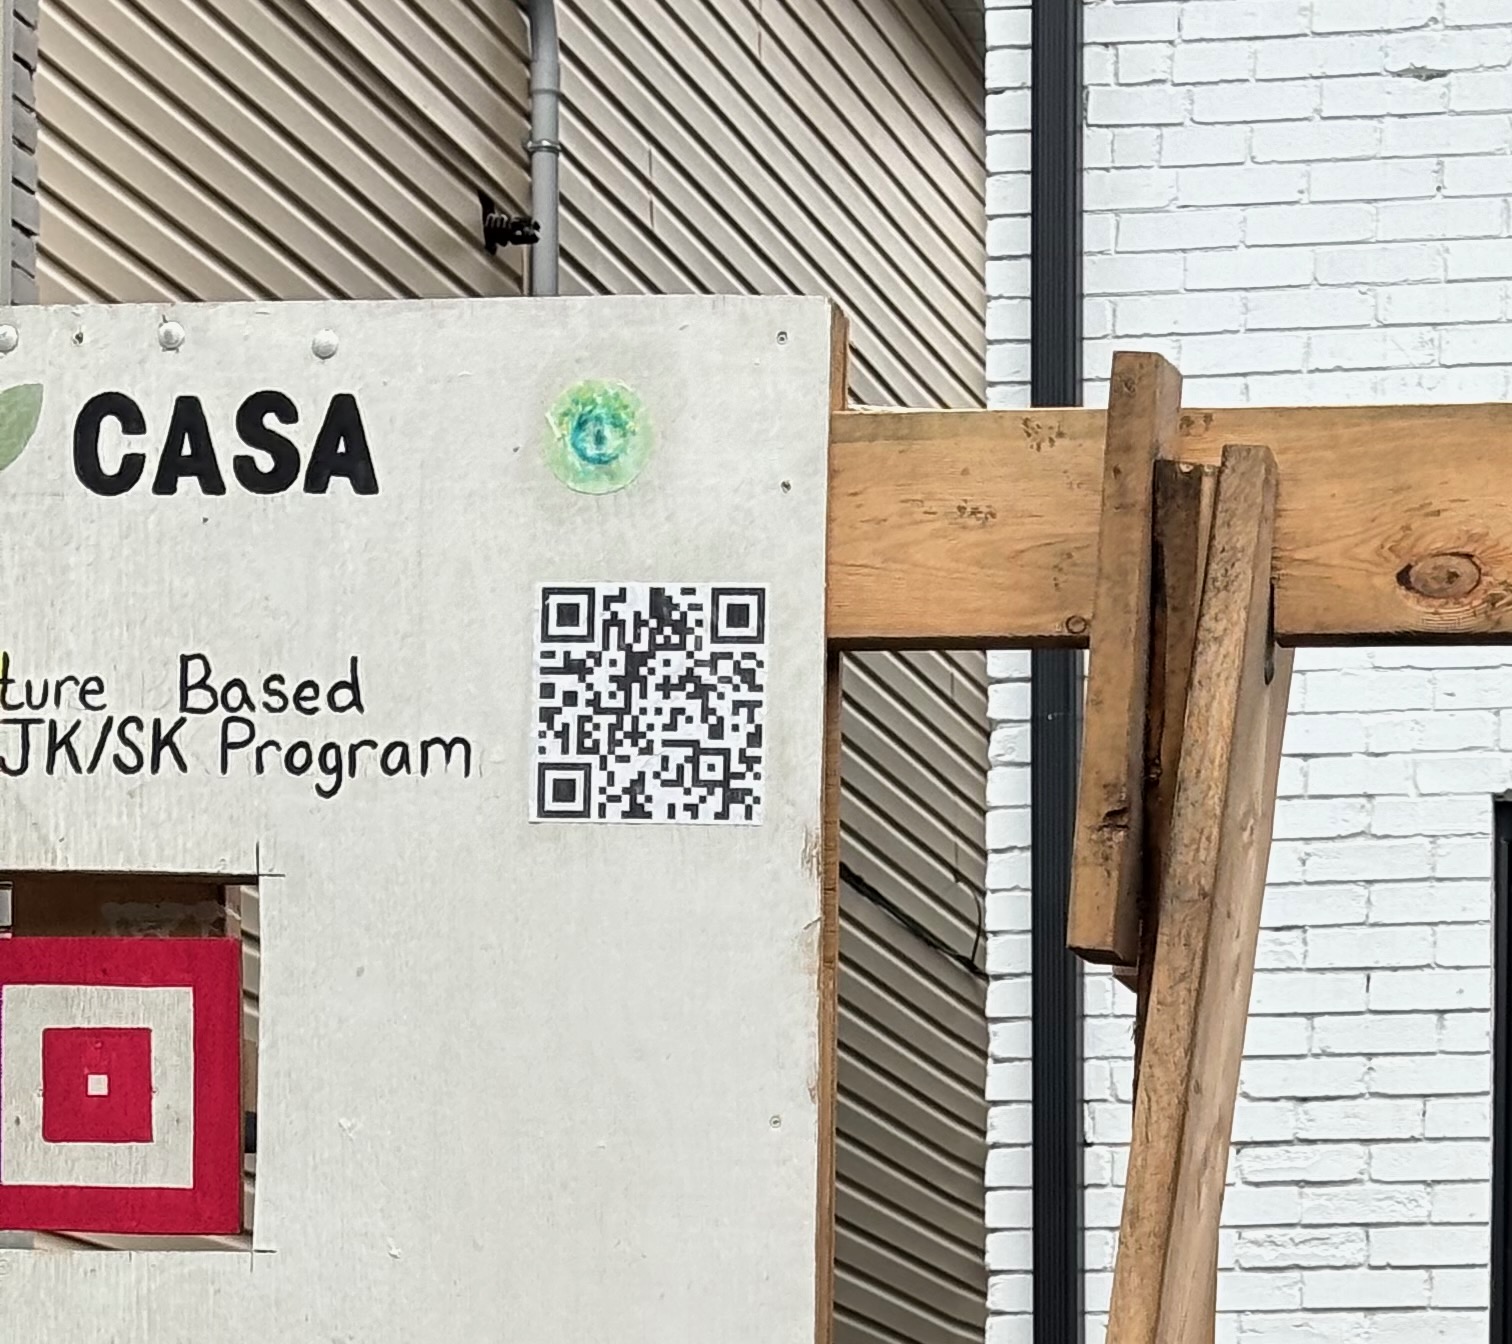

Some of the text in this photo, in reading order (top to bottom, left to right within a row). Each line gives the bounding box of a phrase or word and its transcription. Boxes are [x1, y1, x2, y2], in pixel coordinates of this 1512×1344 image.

[73, 391, 380, 496] CASA
[179, 653, 365, 715] Based
[0, 715, 472, 799] JK/SK Program
